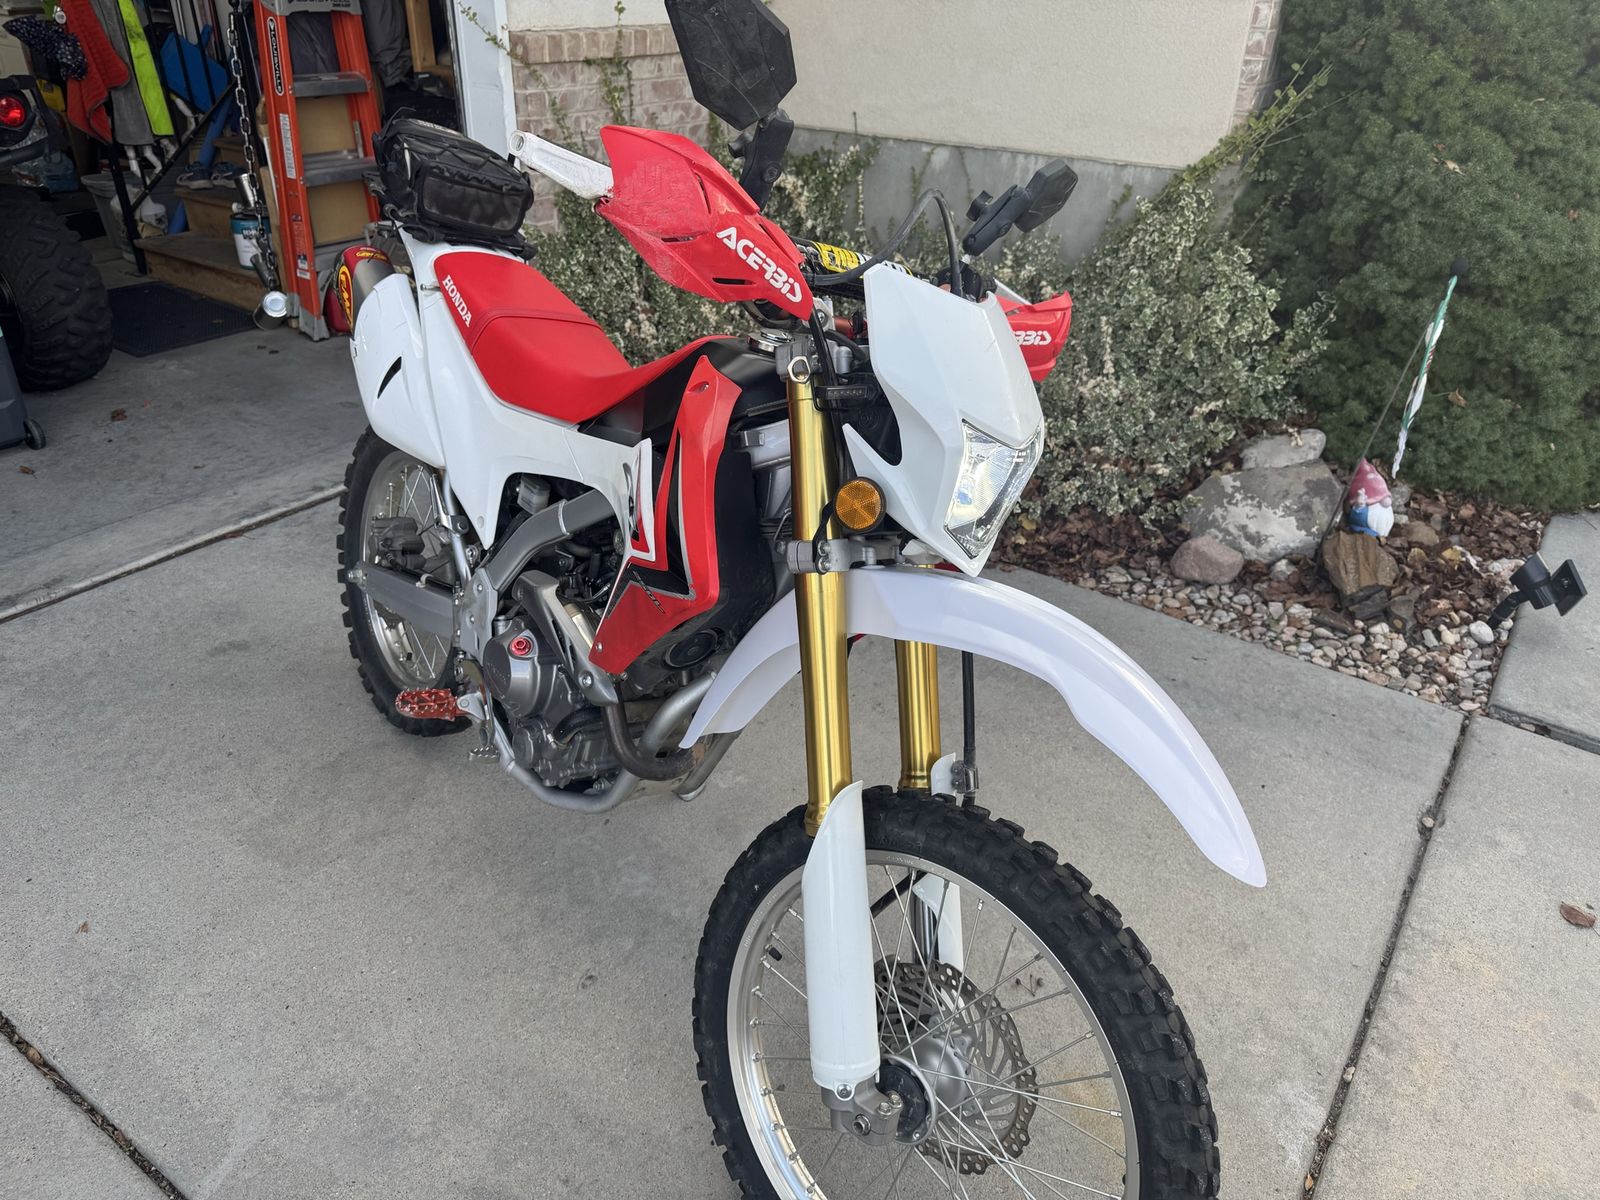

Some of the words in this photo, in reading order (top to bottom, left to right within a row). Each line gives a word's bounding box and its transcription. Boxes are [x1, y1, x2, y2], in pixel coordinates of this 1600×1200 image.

[271, 31, 282, 92] LOUISVILLE
[716, 226, 803, 303] ACERBIS
[442, 274, 472, 328] HONDA
